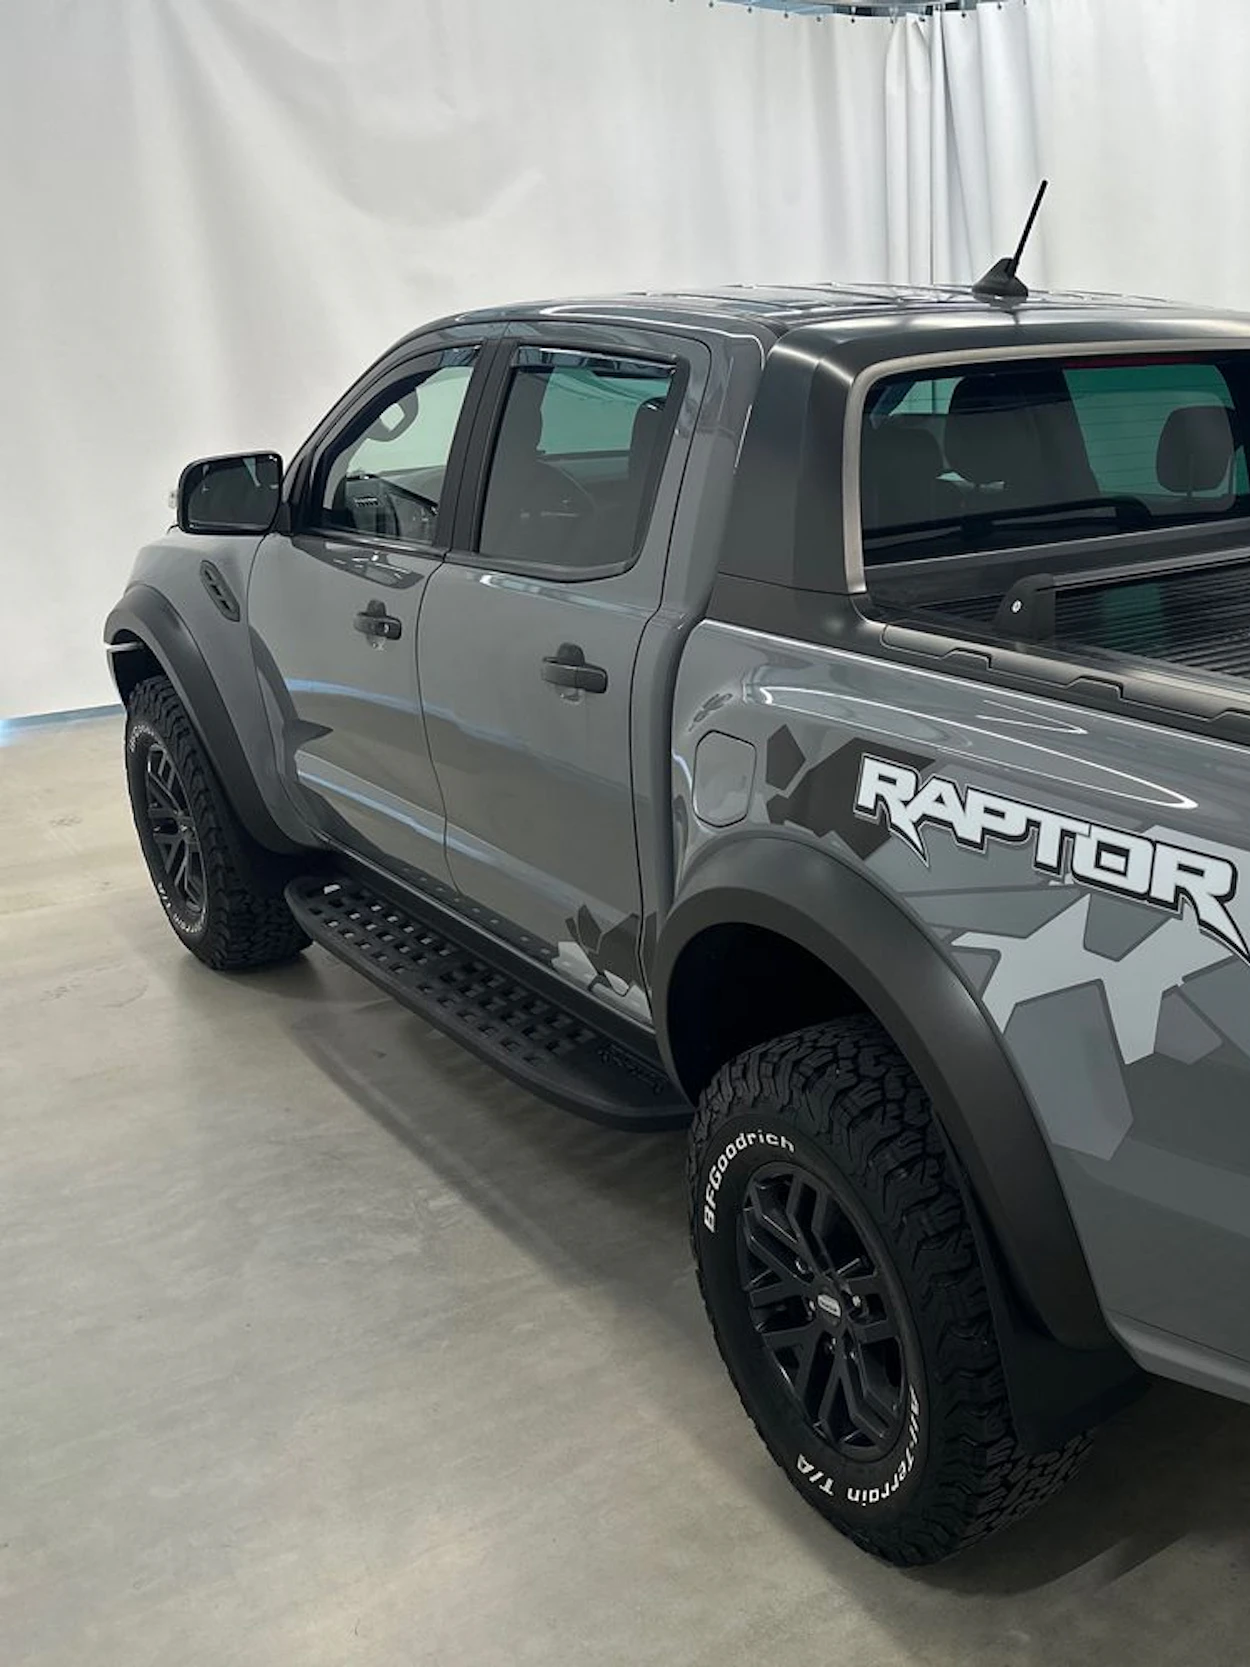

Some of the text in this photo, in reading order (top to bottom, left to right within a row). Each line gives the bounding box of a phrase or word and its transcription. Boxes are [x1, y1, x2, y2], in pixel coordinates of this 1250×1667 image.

[703, 1129, 795, 1234] BFGoodrich
[797, 1384, 919, 1507] All-Terrain T/A
